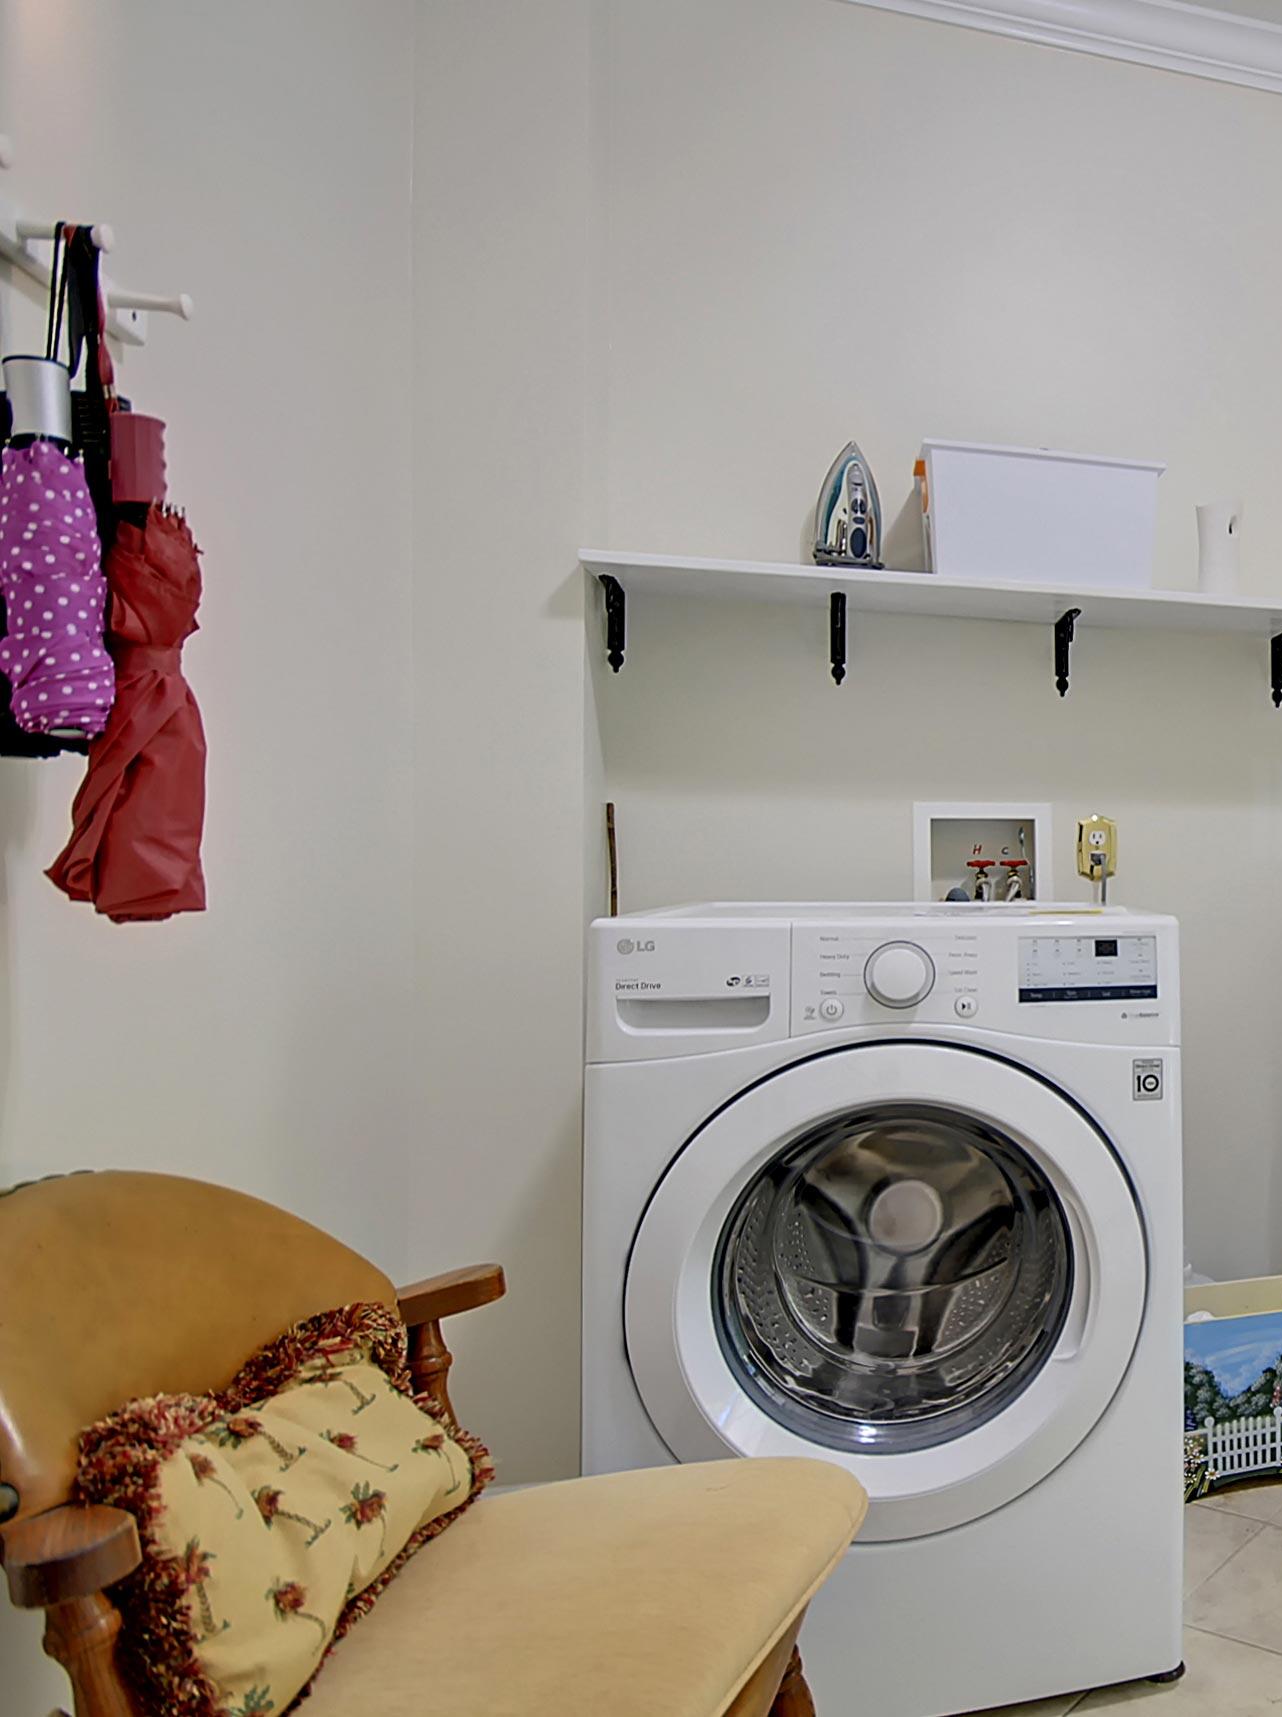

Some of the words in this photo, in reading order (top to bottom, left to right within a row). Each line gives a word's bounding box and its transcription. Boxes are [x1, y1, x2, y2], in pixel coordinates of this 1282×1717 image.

[973, 844, 982, 855] H
[1001, 846, 1009, 855] C
[637, 941, 656, 952] LG
[615, 982, 639, 991] Direct
[640, 981, 662, 990] Drive
[1136, 1074, 1159, 1092] 10
